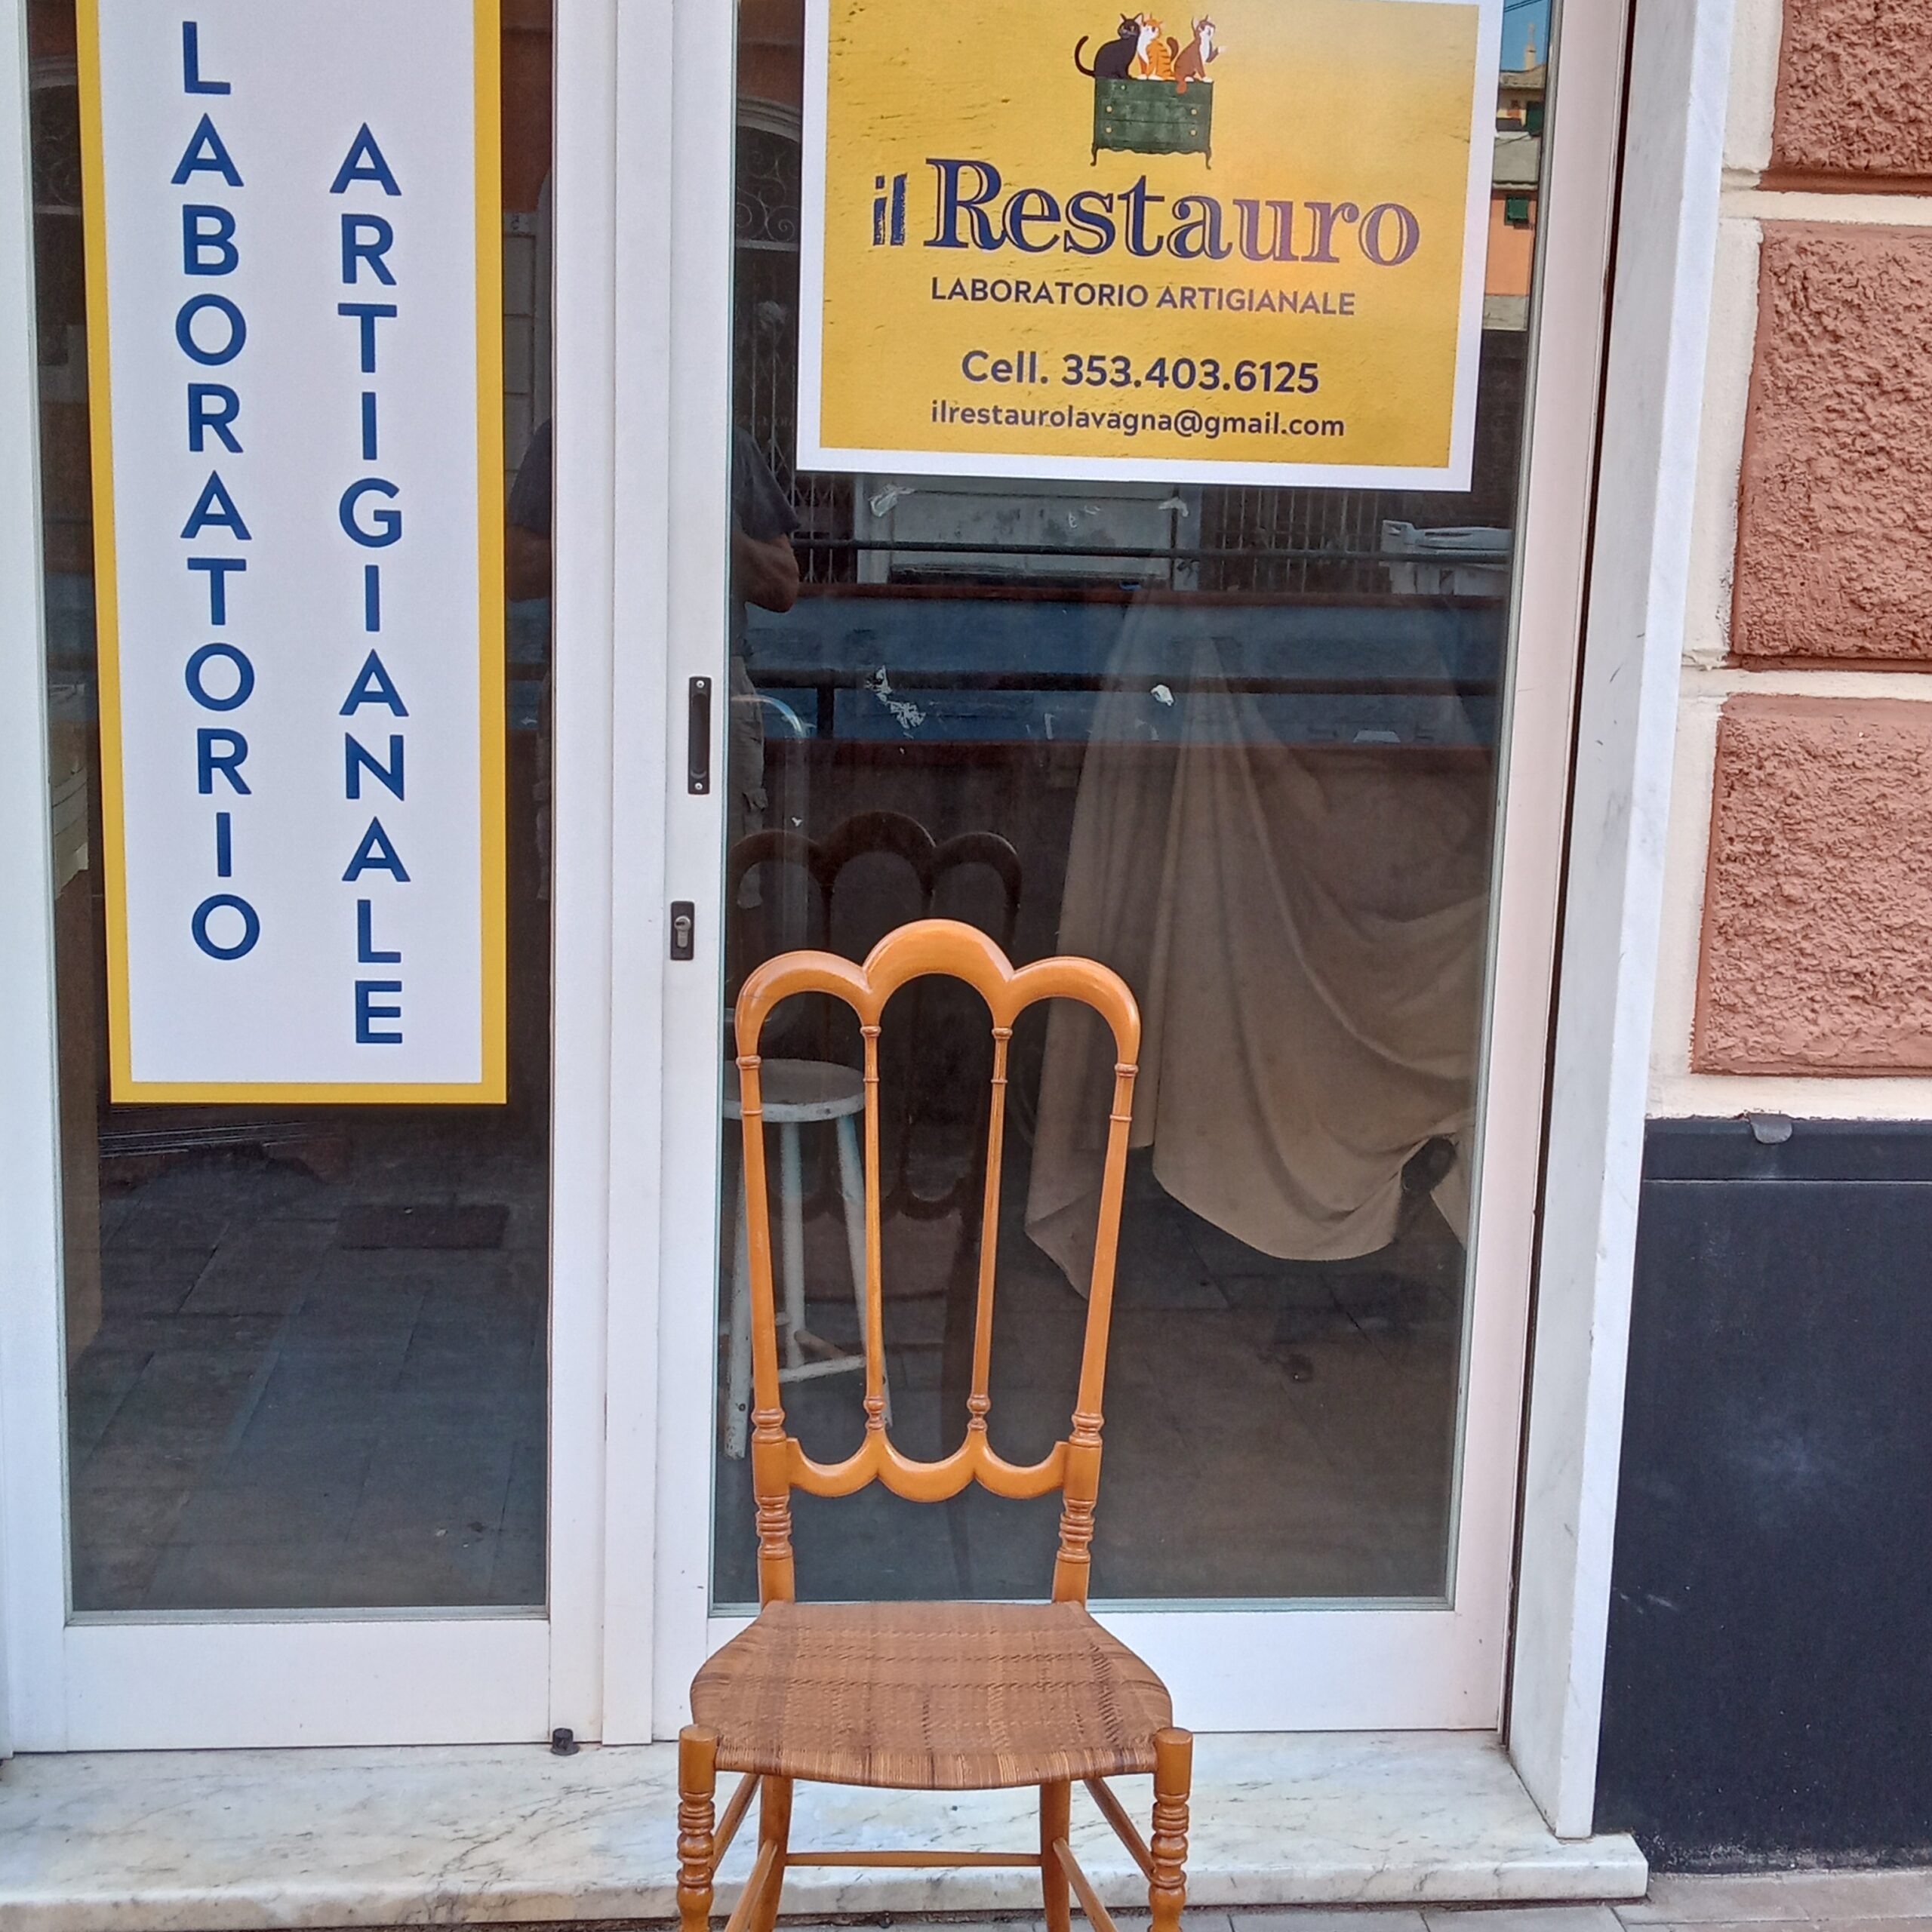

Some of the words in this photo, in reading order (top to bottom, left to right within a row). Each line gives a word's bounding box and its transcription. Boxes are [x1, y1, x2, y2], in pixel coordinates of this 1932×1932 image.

[872, 173, 907, 247] il
[924, 158, 1420, 266] Restauro
[931, 276, 1149, 307] LABORATORIO
[1156, 285, 1354, 315] ARTIGIANALE
[961, 350, 1048, 384] Cell.
[1061, 353, 1318, 394] 353.403.6125
[932, 399, 1344, 439] ilrestaurolavagna@gmail.com
[171, 21, 260, 960] LABORATORIO
[329, 123, 411, 1044] ARTIGIANALE
